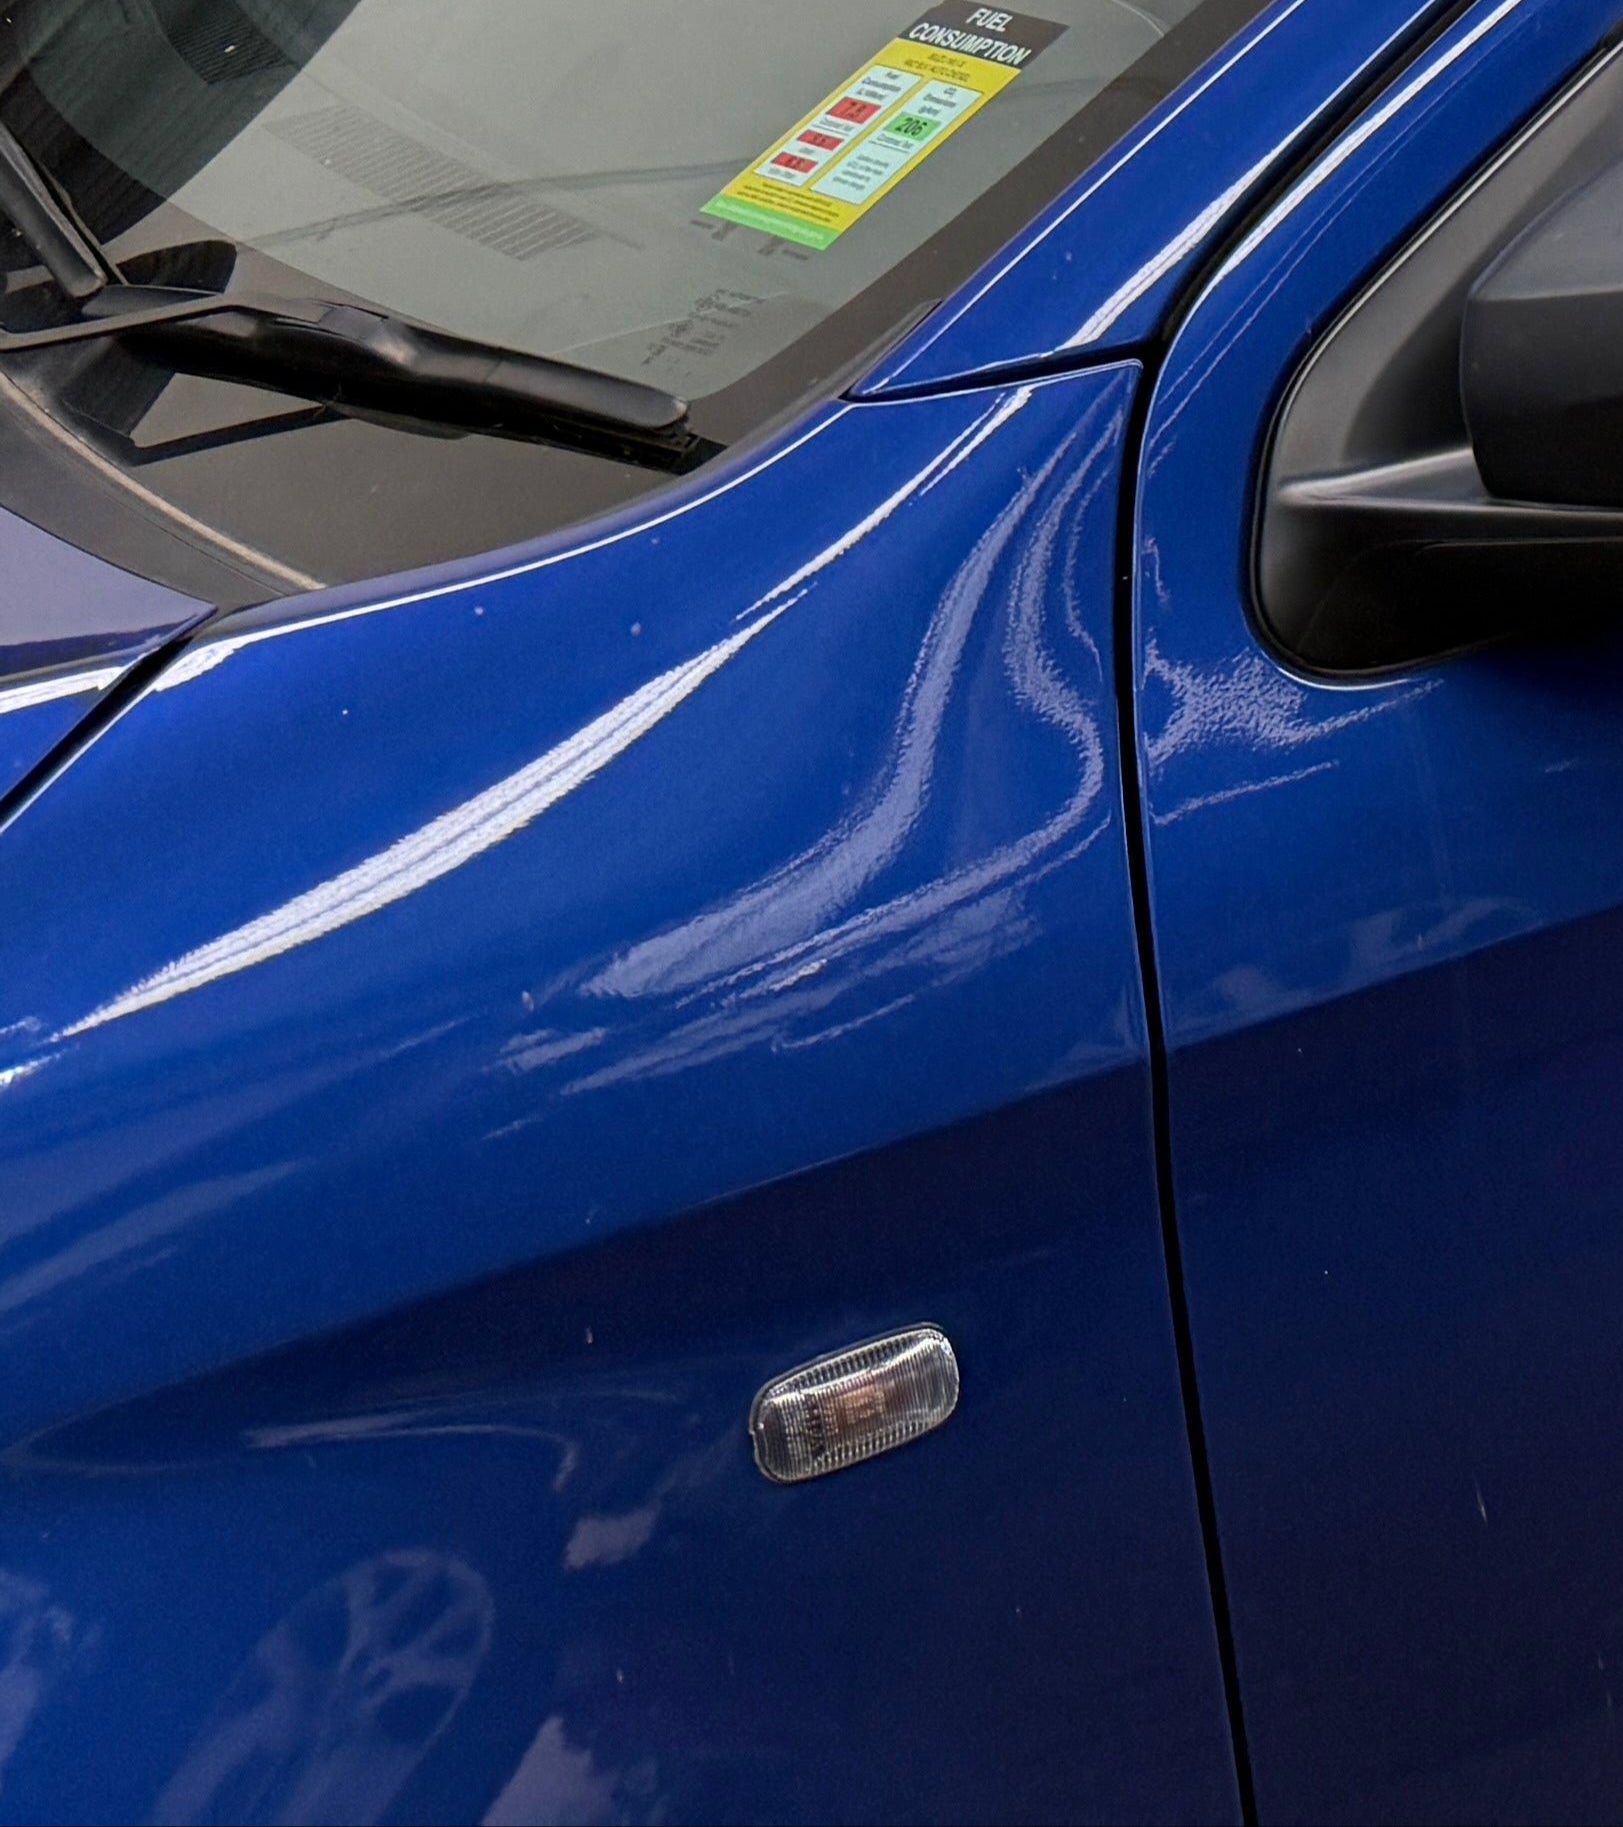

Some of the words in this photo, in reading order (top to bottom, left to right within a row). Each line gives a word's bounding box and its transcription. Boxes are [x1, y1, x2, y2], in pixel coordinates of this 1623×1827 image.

[966, 7, 1013, 32] FUEL
[909, 23, 1031, 65] CONSUMPTION
[896, 117, 927, 136] 206
